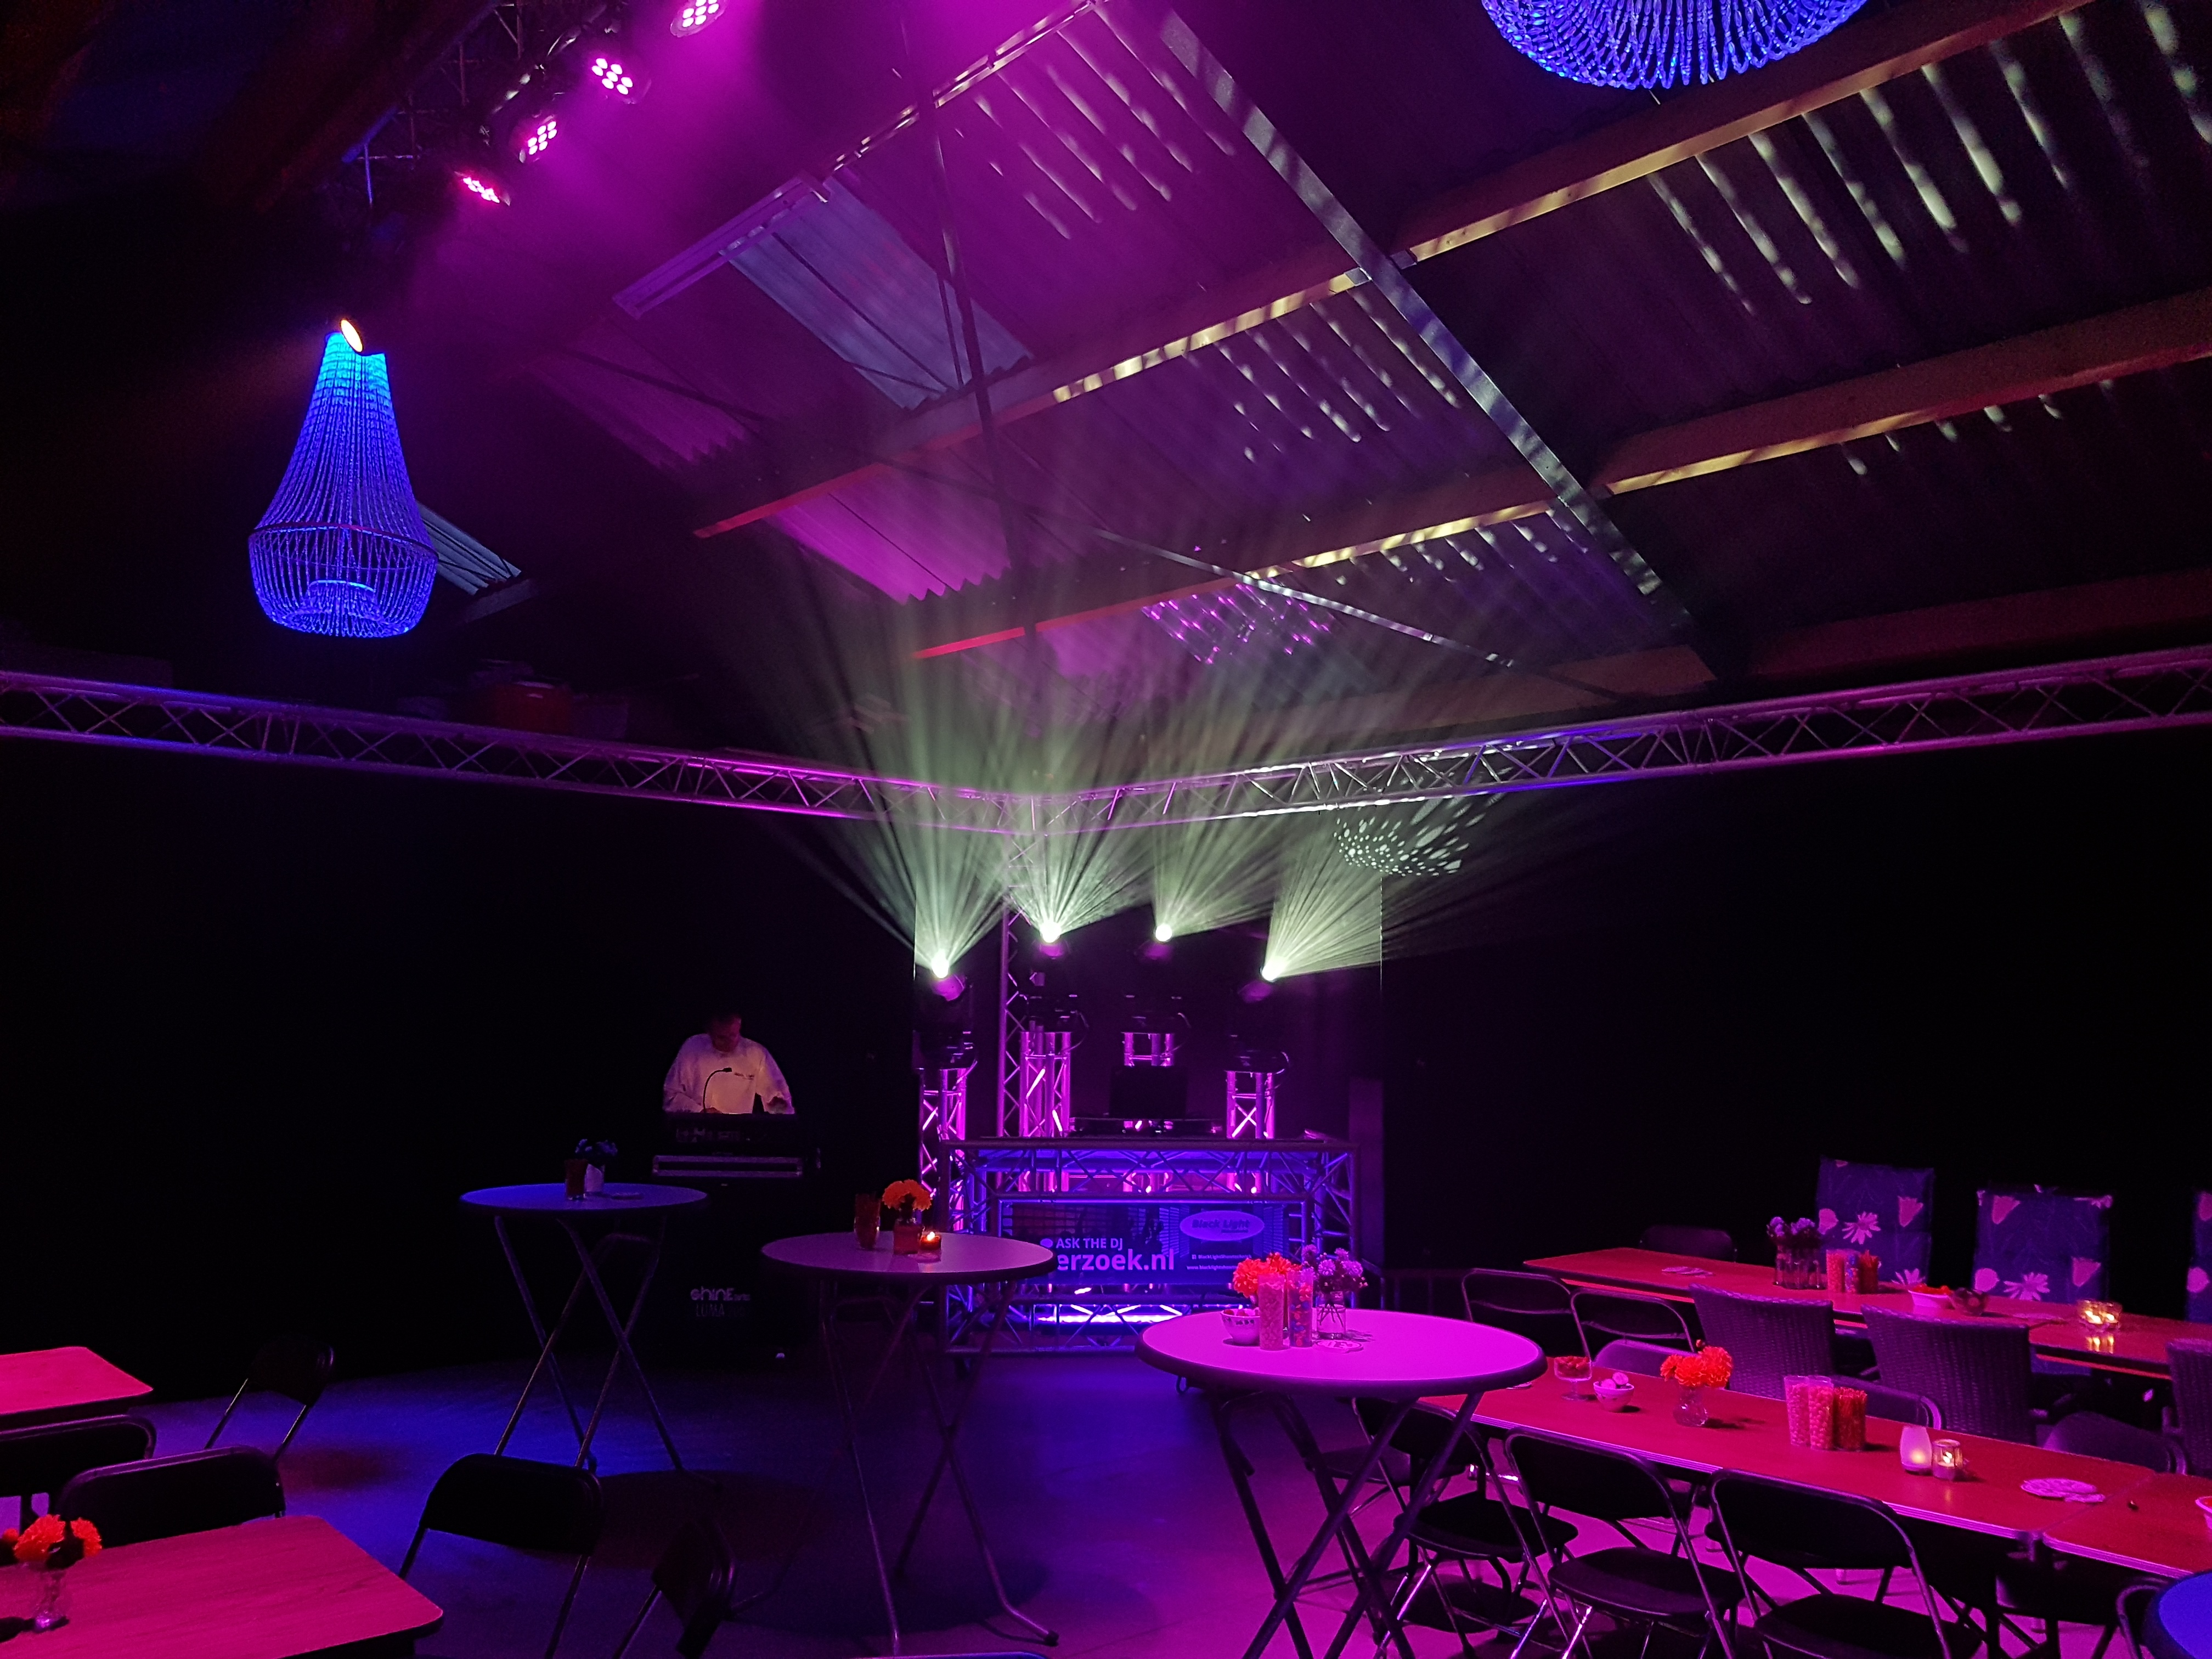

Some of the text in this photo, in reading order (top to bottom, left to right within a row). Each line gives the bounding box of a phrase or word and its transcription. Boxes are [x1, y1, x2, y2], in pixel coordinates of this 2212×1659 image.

[1192, 1219, 1251, 1229] Black Light
[1056, 1238, 1124, 1251] ASK THE DJ
[1057, 1248, 1175, 1271] erzoek.nl
